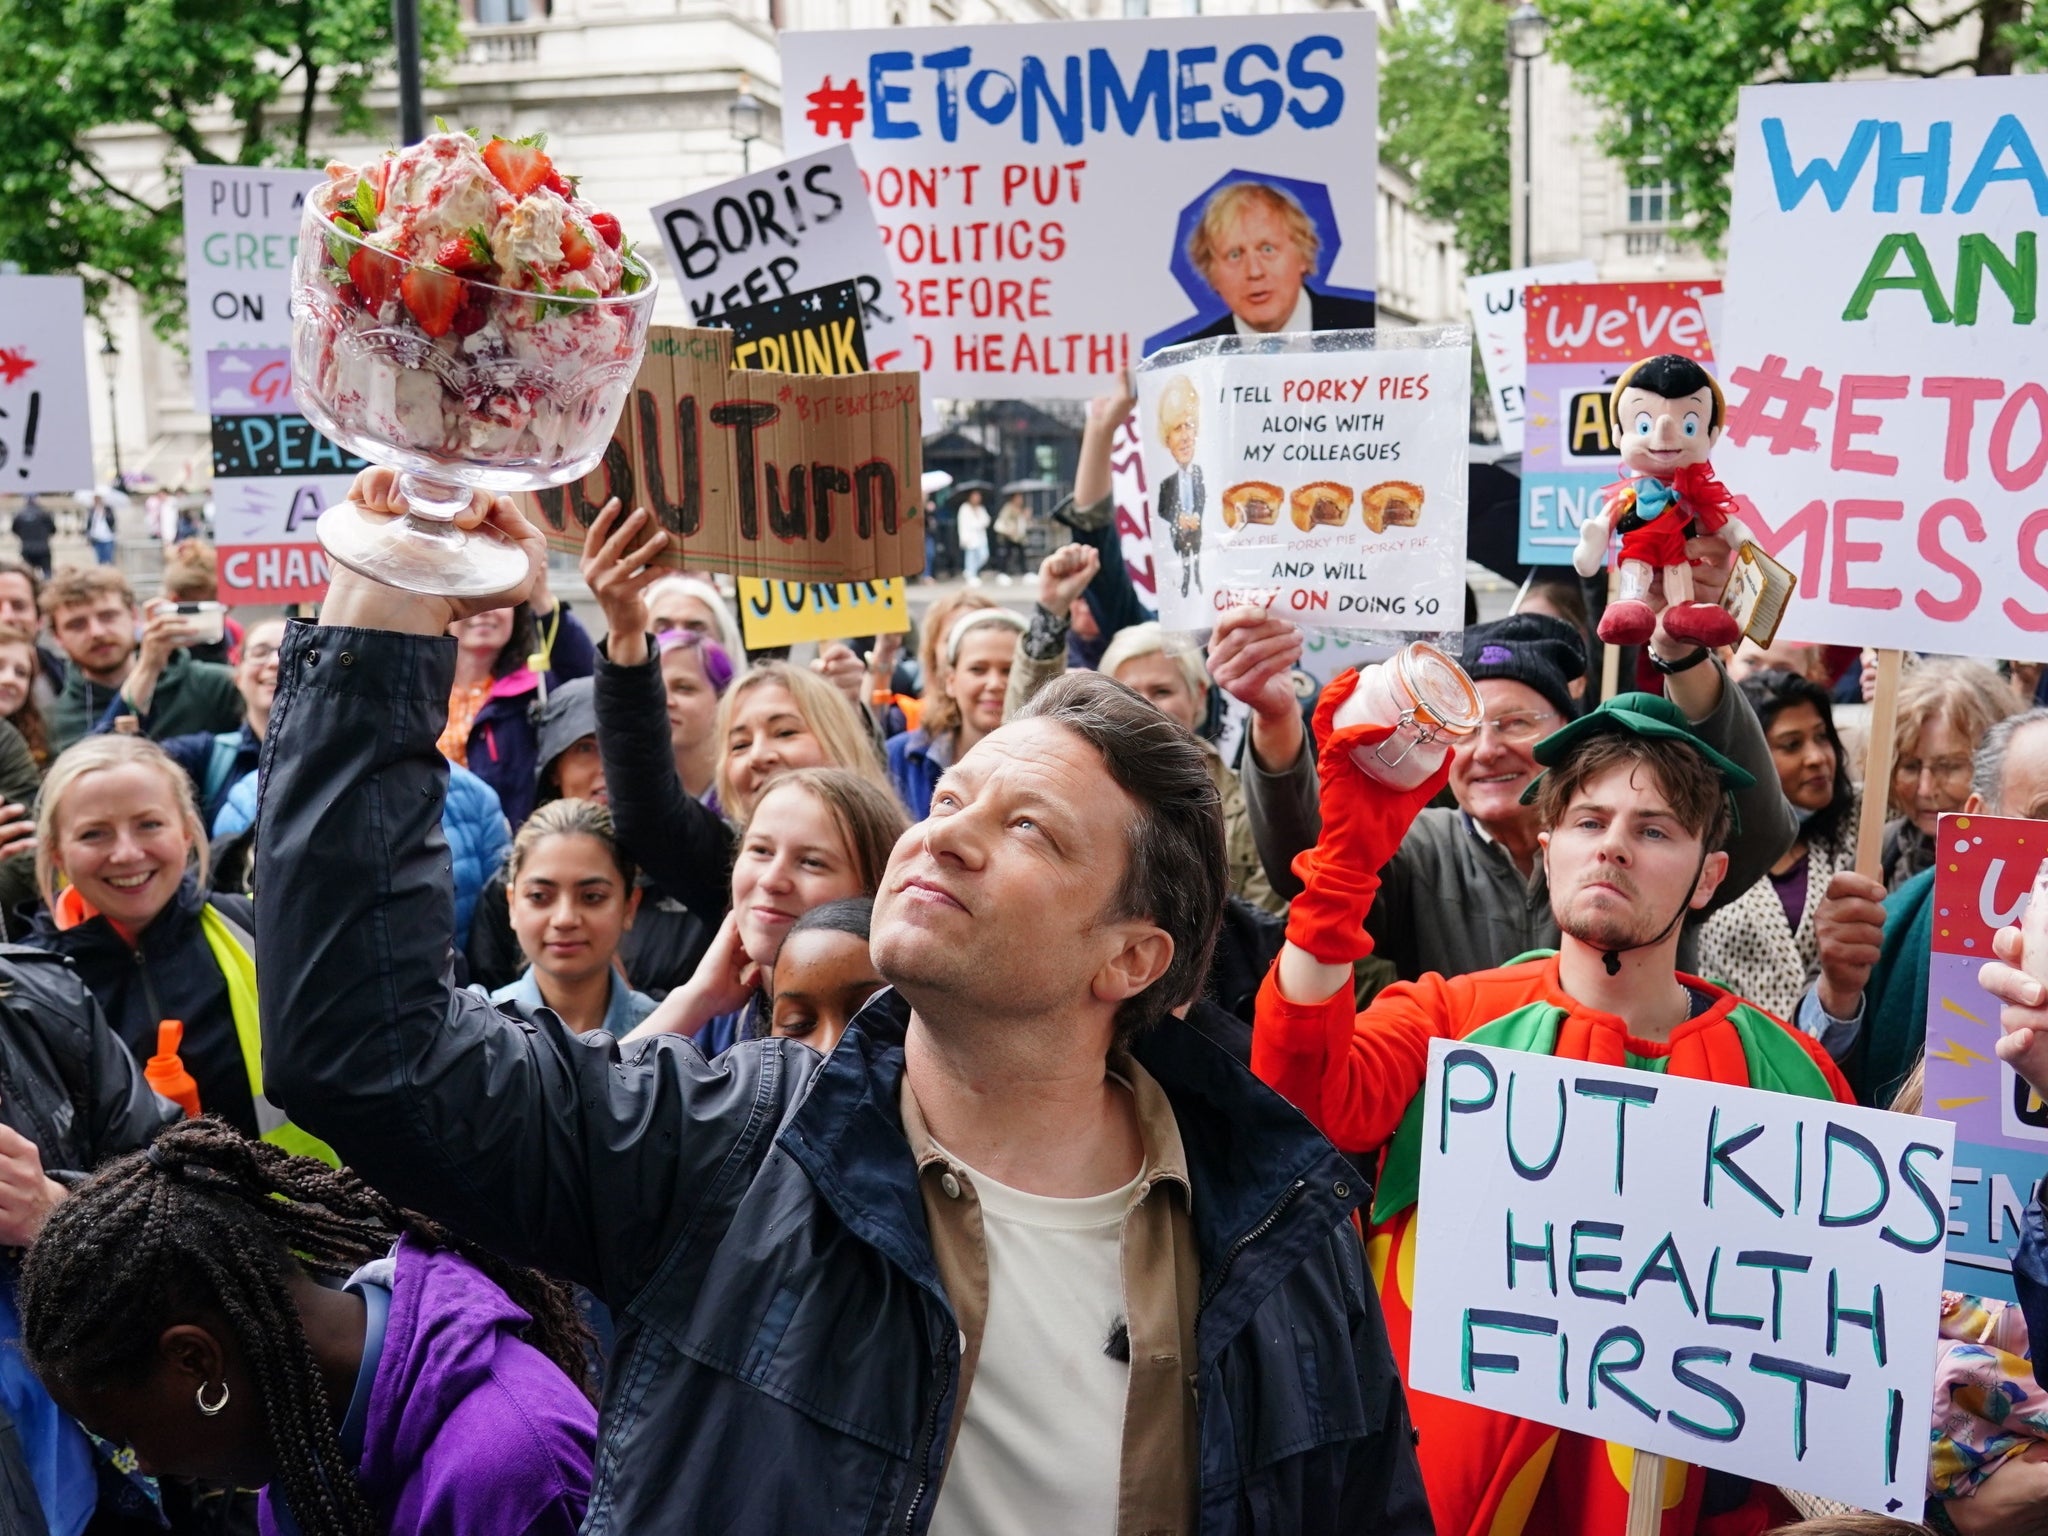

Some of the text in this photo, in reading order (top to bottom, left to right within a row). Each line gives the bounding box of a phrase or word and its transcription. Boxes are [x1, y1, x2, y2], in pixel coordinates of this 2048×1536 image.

[1003, 160, 1087, 206] PUT
[1761, 114, 2048, 216] WHA
[211, 180, 272, 218] PUT
[1842, 231, 2037, 325] AN
[212, 291, 264, 323] ON
[955, 332, 1129, 375] HEALTH!
[1220, 374, 1430, 404] I TELL PORKY PIES
[1262, 414, 1385, 433] ALONG WITH
[1725, 354, 2048, 492] #ETO
[1243, 441, 1402, 463] MY COLLEAGUES
[1272, 562, 1367, 580] AND WILL
[1213, 586, 1440, 615] CAY ON DOING SO
[1440, 1049, 1944, 1254] PUT KIDS
[1506, 1207, 1887, 1368] HEALTH
[1460, 1307, 1905, 1513] FIRST!
